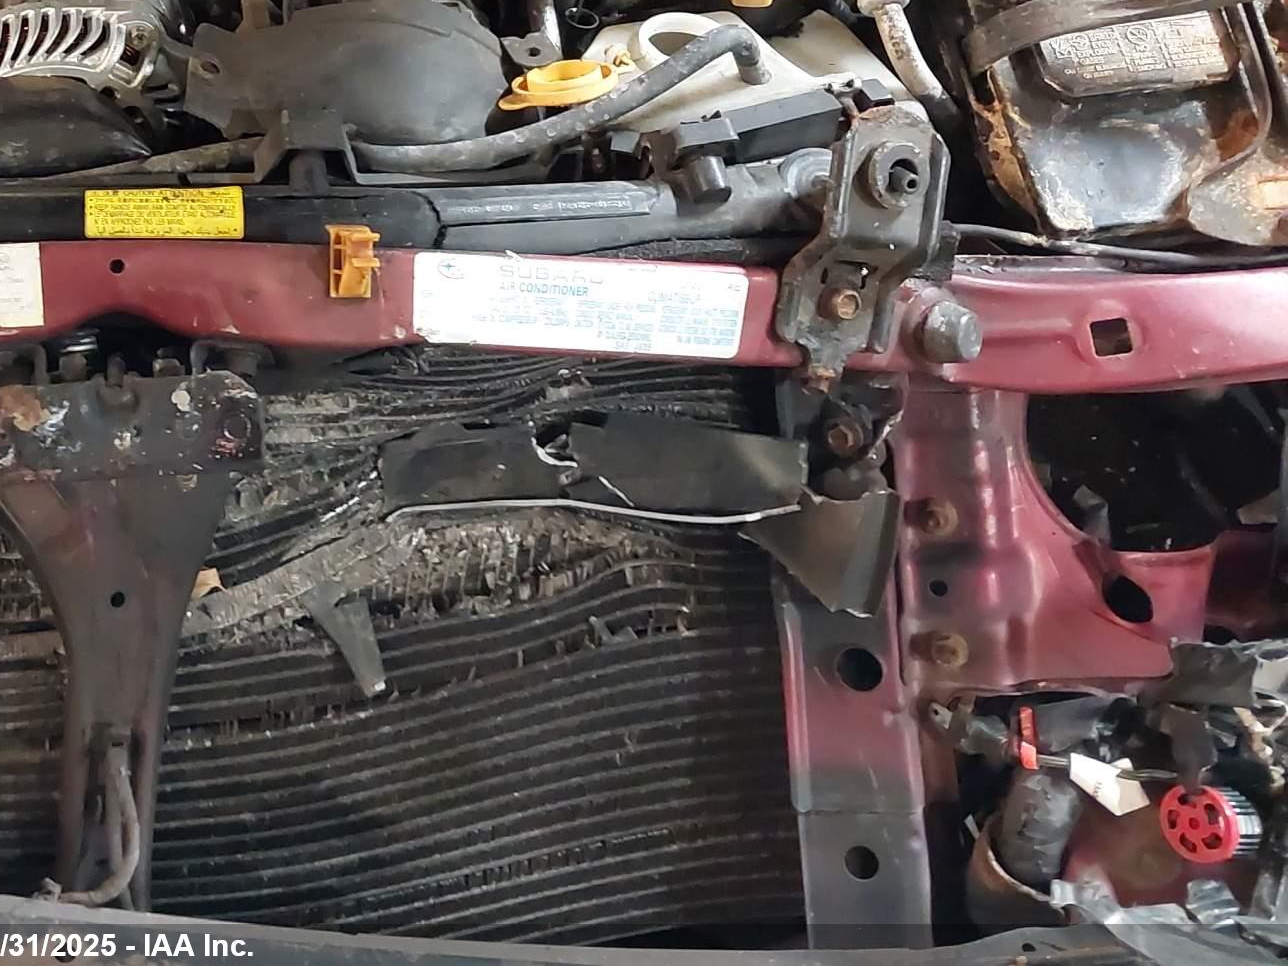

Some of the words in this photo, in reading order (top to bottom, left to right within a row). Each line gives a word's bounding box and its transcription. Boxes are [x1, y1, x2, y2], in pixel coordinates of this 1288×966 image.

[499, 264, 604, 285] SUBARU
[499, 282, 516, 291] AIR
[519, 283, 590, 297] CONDITIONER
